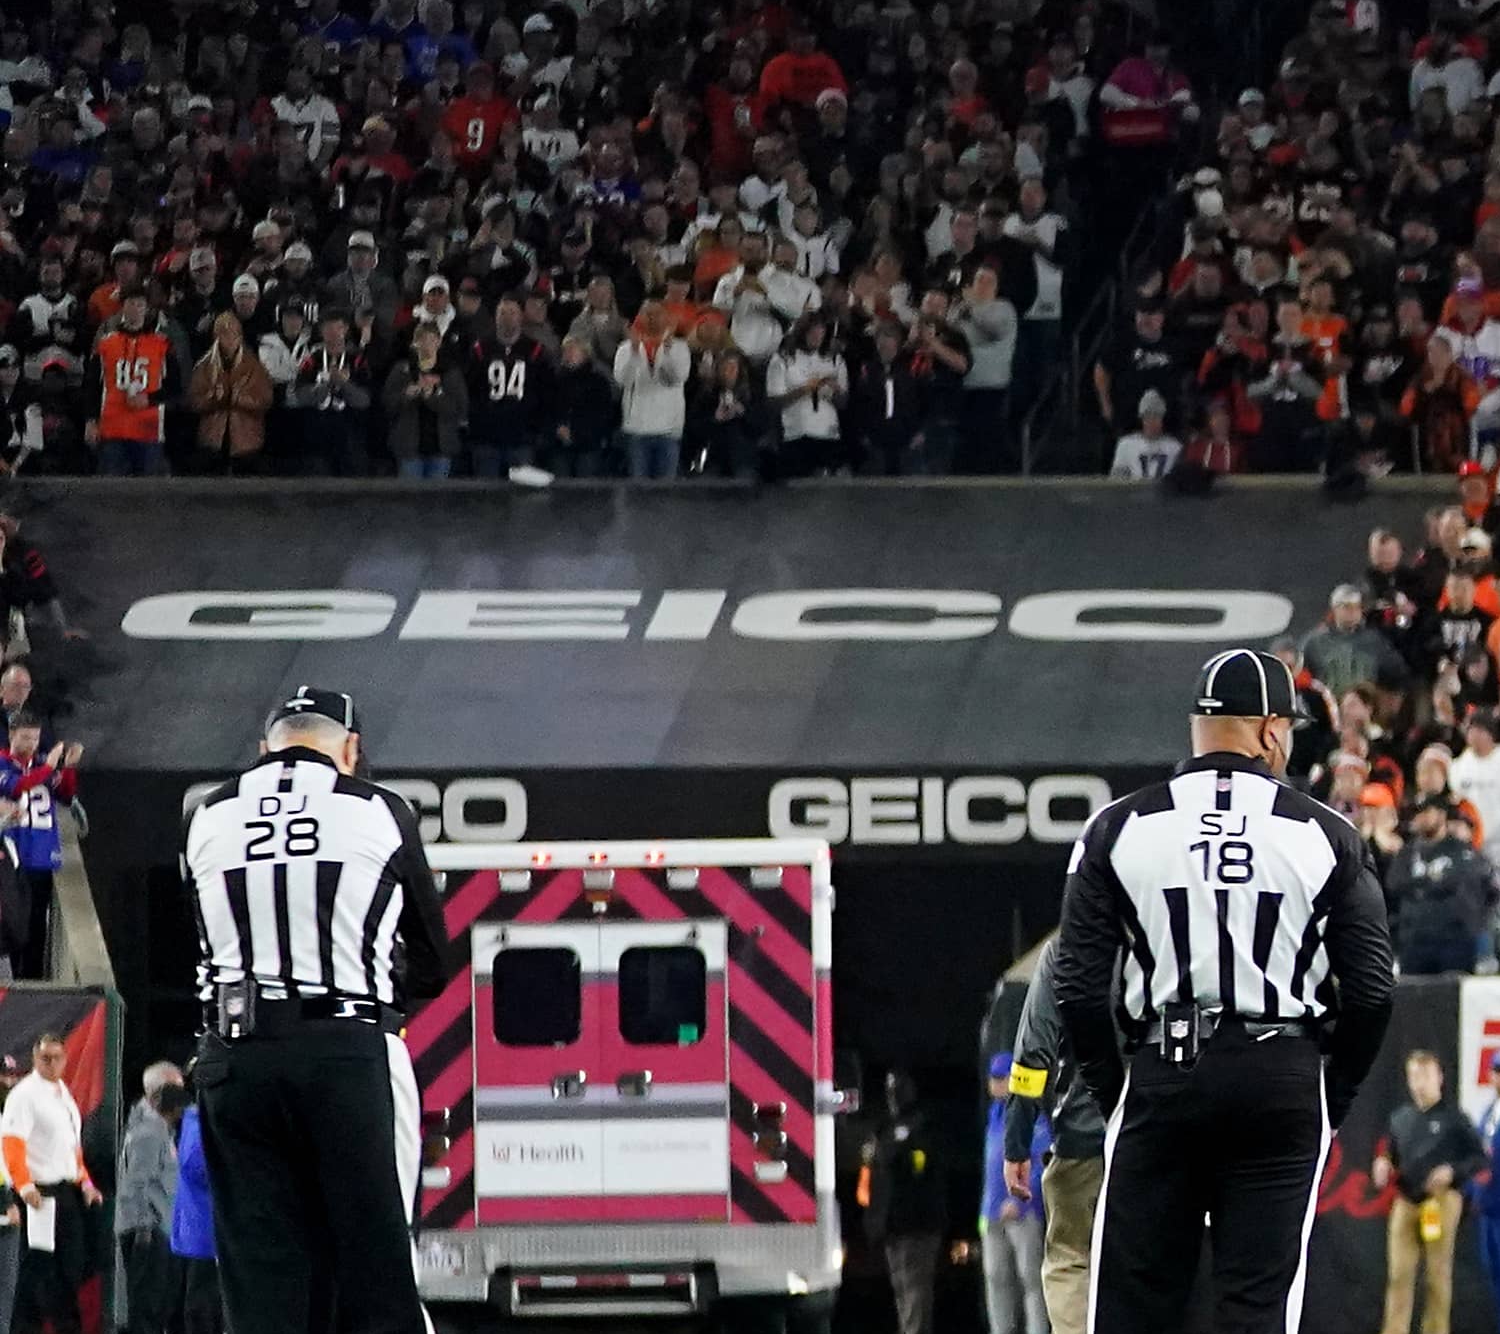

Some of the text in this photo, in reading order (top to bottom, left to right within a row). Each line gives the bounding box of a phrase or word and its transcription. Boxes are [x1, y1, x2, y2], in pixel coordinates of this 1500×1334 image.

[466, 117, 486, 152] 9
[486, 359, 529, 401] 94
[120, 589, 1293, 642] GEICO
[259, 795, 309, 822] DJ
[768, 775, 1113, 845] GEICO
[1199, 813, 1248, 837] SJ
[245, 817, 321, 862] 28
[1188, 840, 1255, 885] 18
